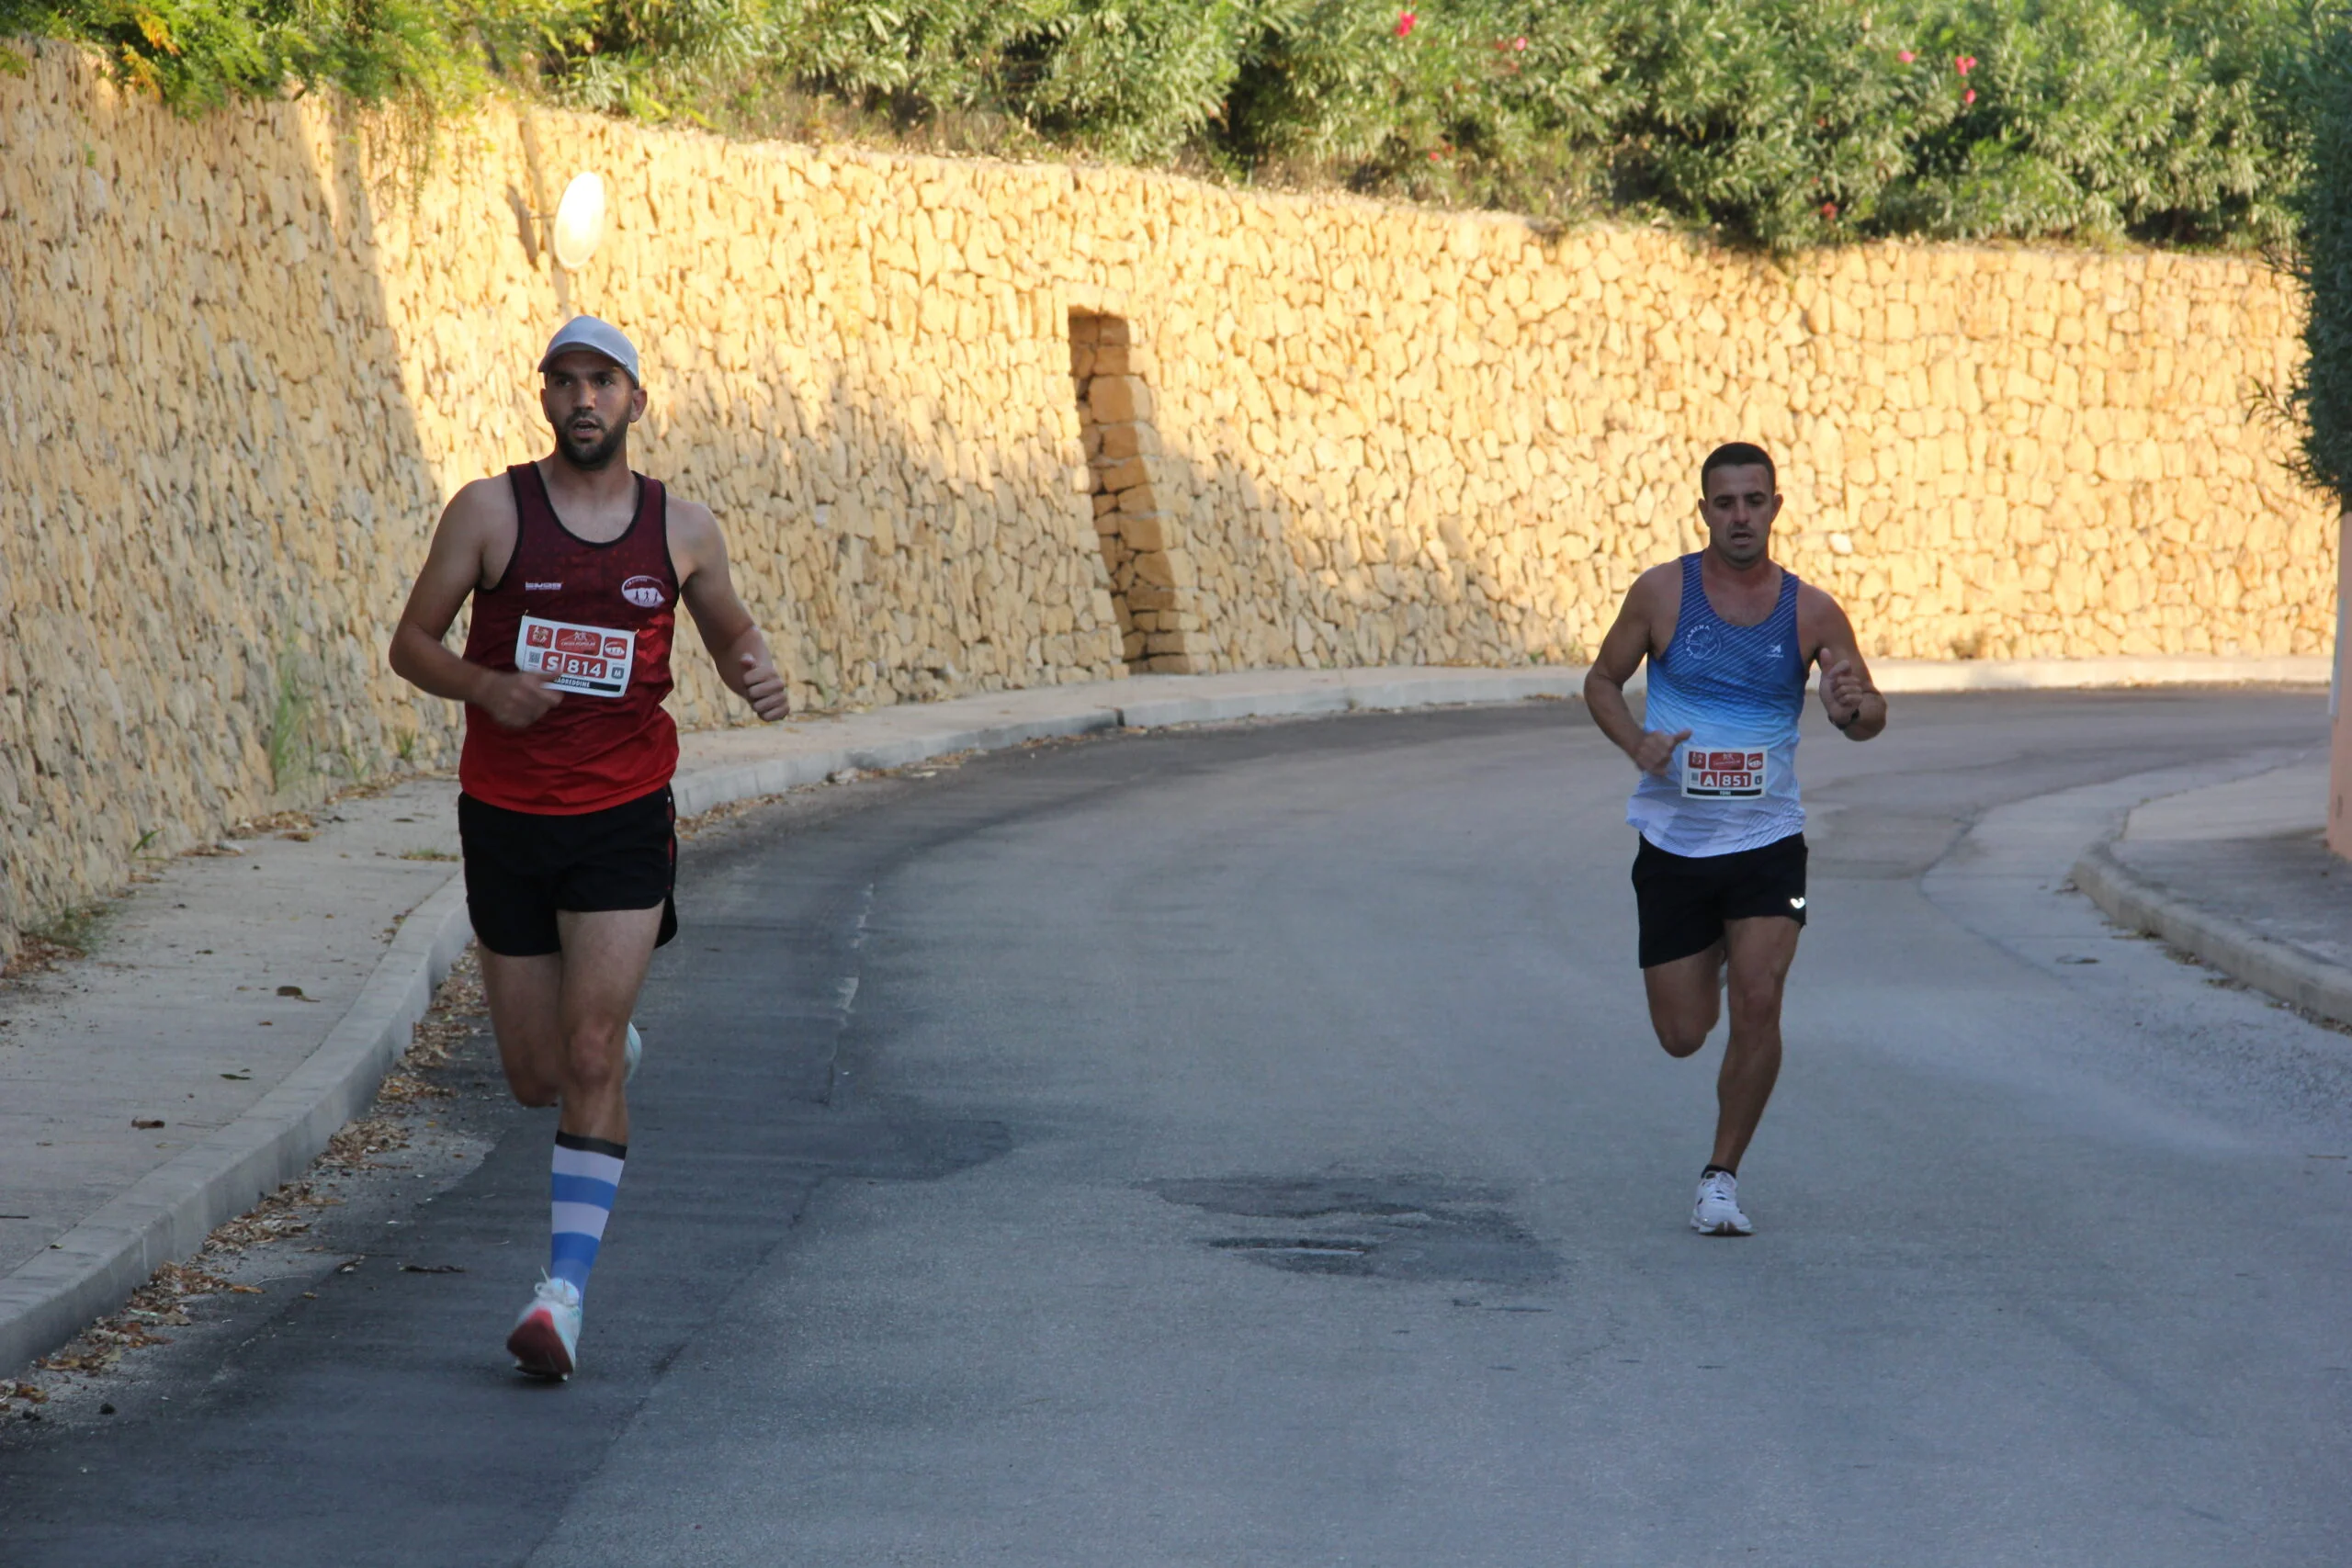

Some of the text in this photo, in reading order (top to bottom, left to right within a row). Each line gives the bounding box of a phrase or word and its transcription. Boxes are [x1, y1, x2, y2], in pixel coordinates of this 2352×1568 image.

[547, 656, 602, 678] S 814
[1703, 774, 1748, 786] A 851
